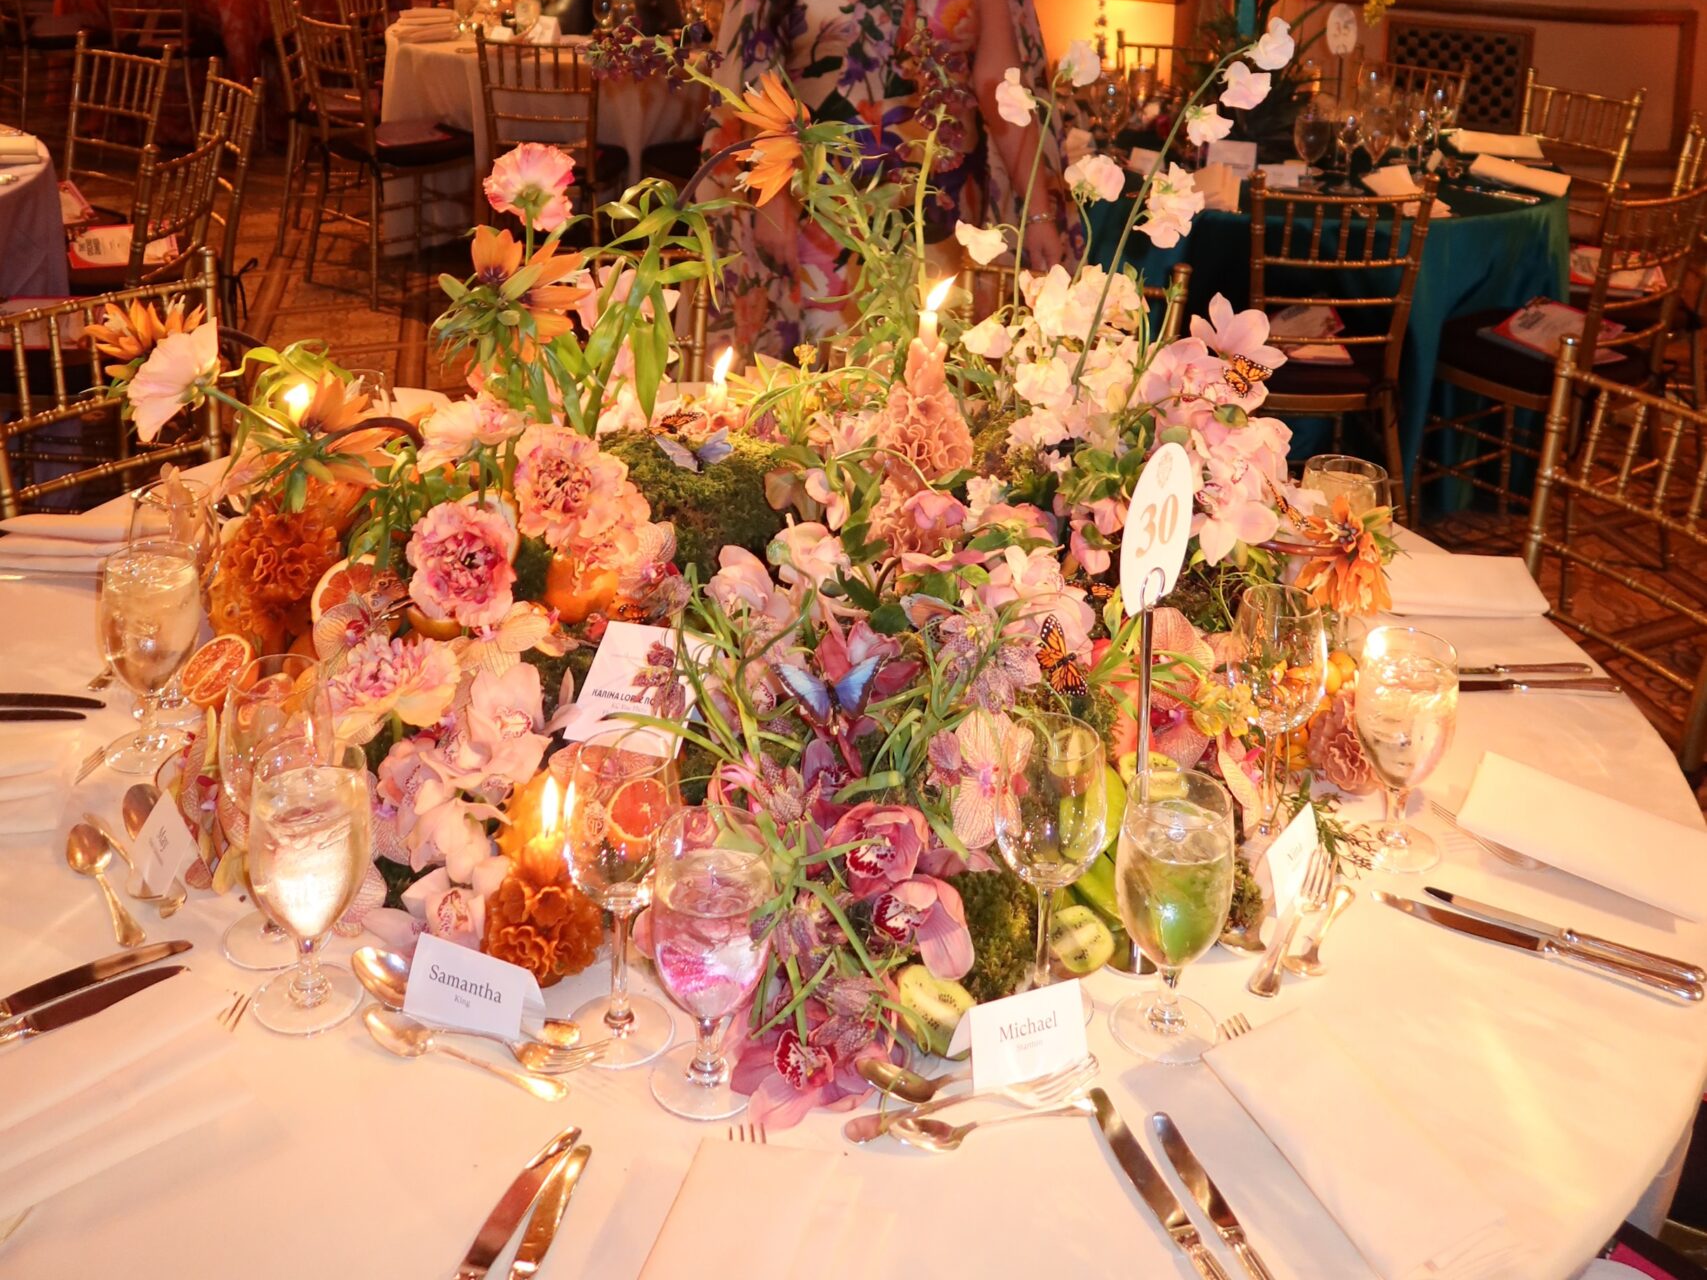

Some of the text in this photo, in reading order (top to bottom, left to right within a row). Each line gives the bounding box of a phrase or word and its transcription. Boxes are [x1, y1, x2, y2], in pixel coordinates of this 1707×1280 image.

[1135, 493, 1179, 558] 30
[620, 693, 643, 704] LOPZ
[429, 964, 502, 1004] Samantha
[454, 994, 471, 1008] King
[999, 1010, 1058, 1043] Michael
